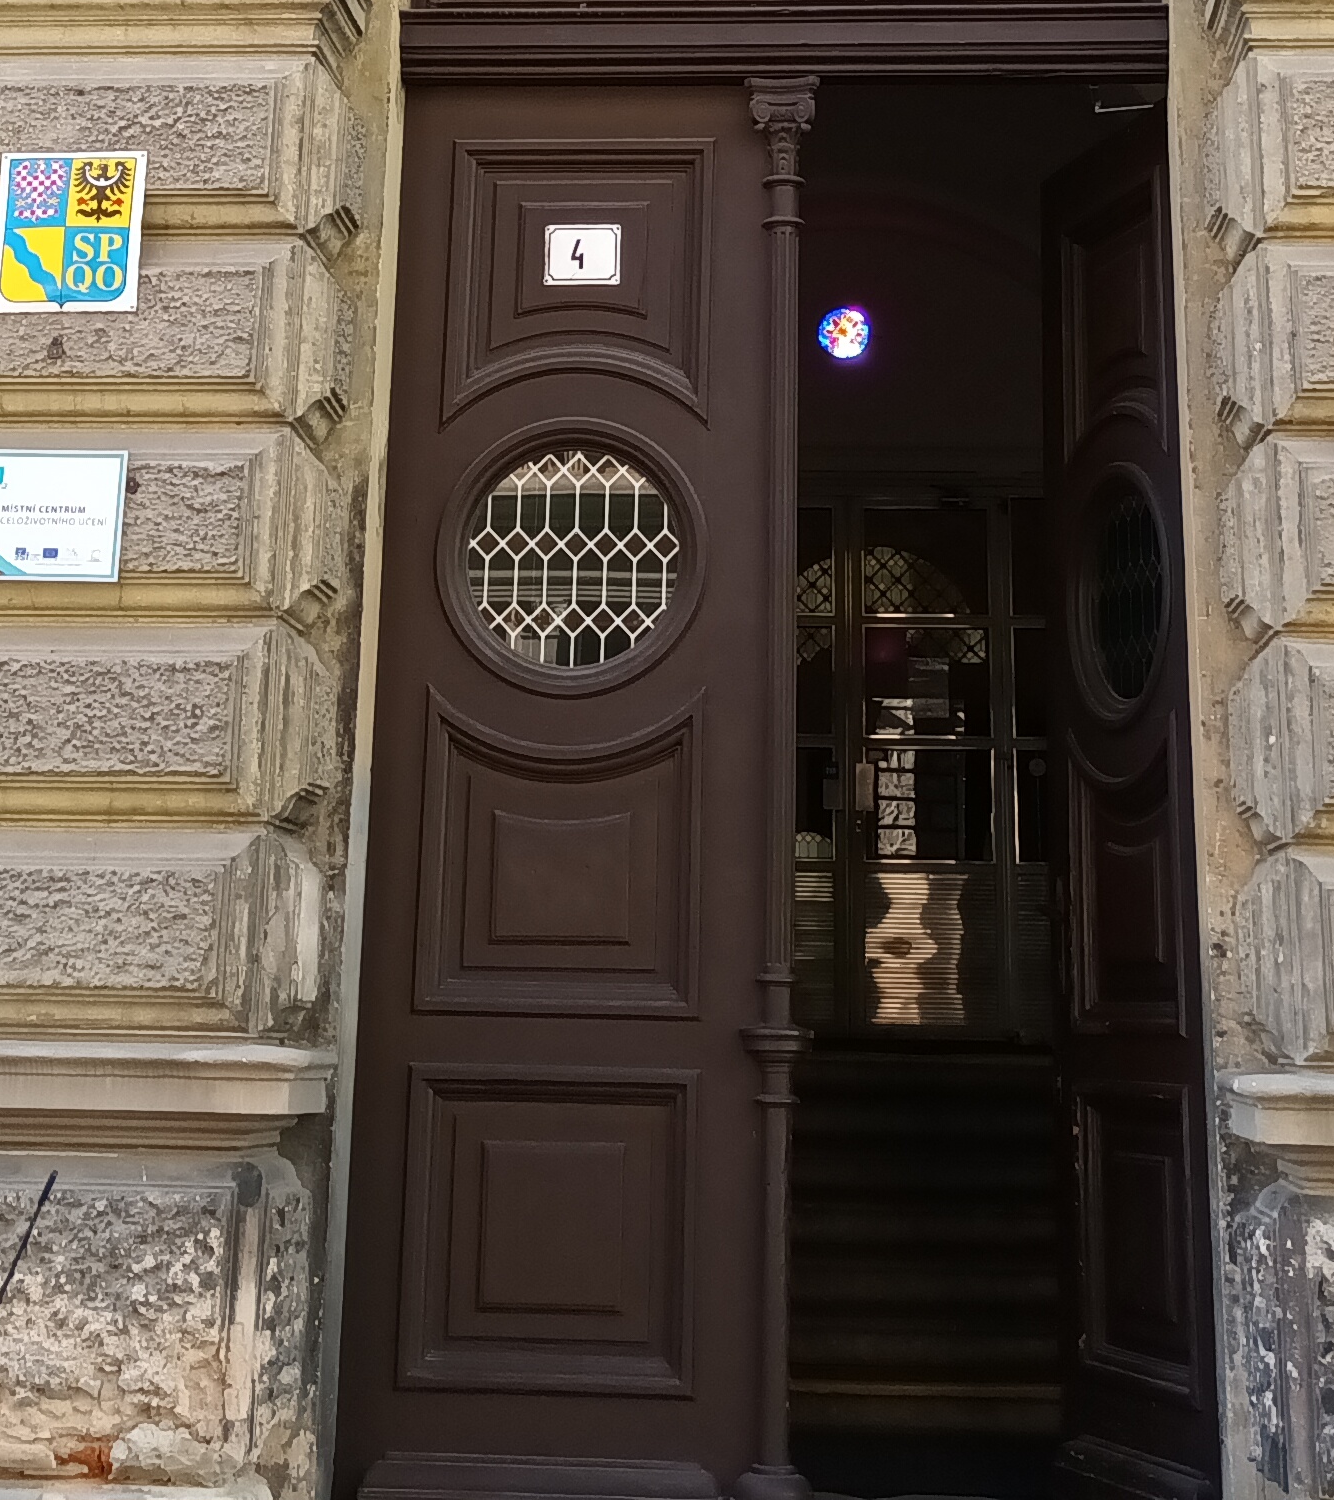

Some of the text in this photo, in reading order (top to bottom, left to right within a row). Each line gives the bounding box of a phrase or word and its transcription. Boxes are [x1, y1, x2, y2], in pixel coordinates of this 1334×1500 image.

[72, 232, 123, 262] SP
[570, 238, 584, 270] 4
[65, 263, 124, 293] QO
[1, 503, 86, 514] MÍSTNÍ CENTRUM
